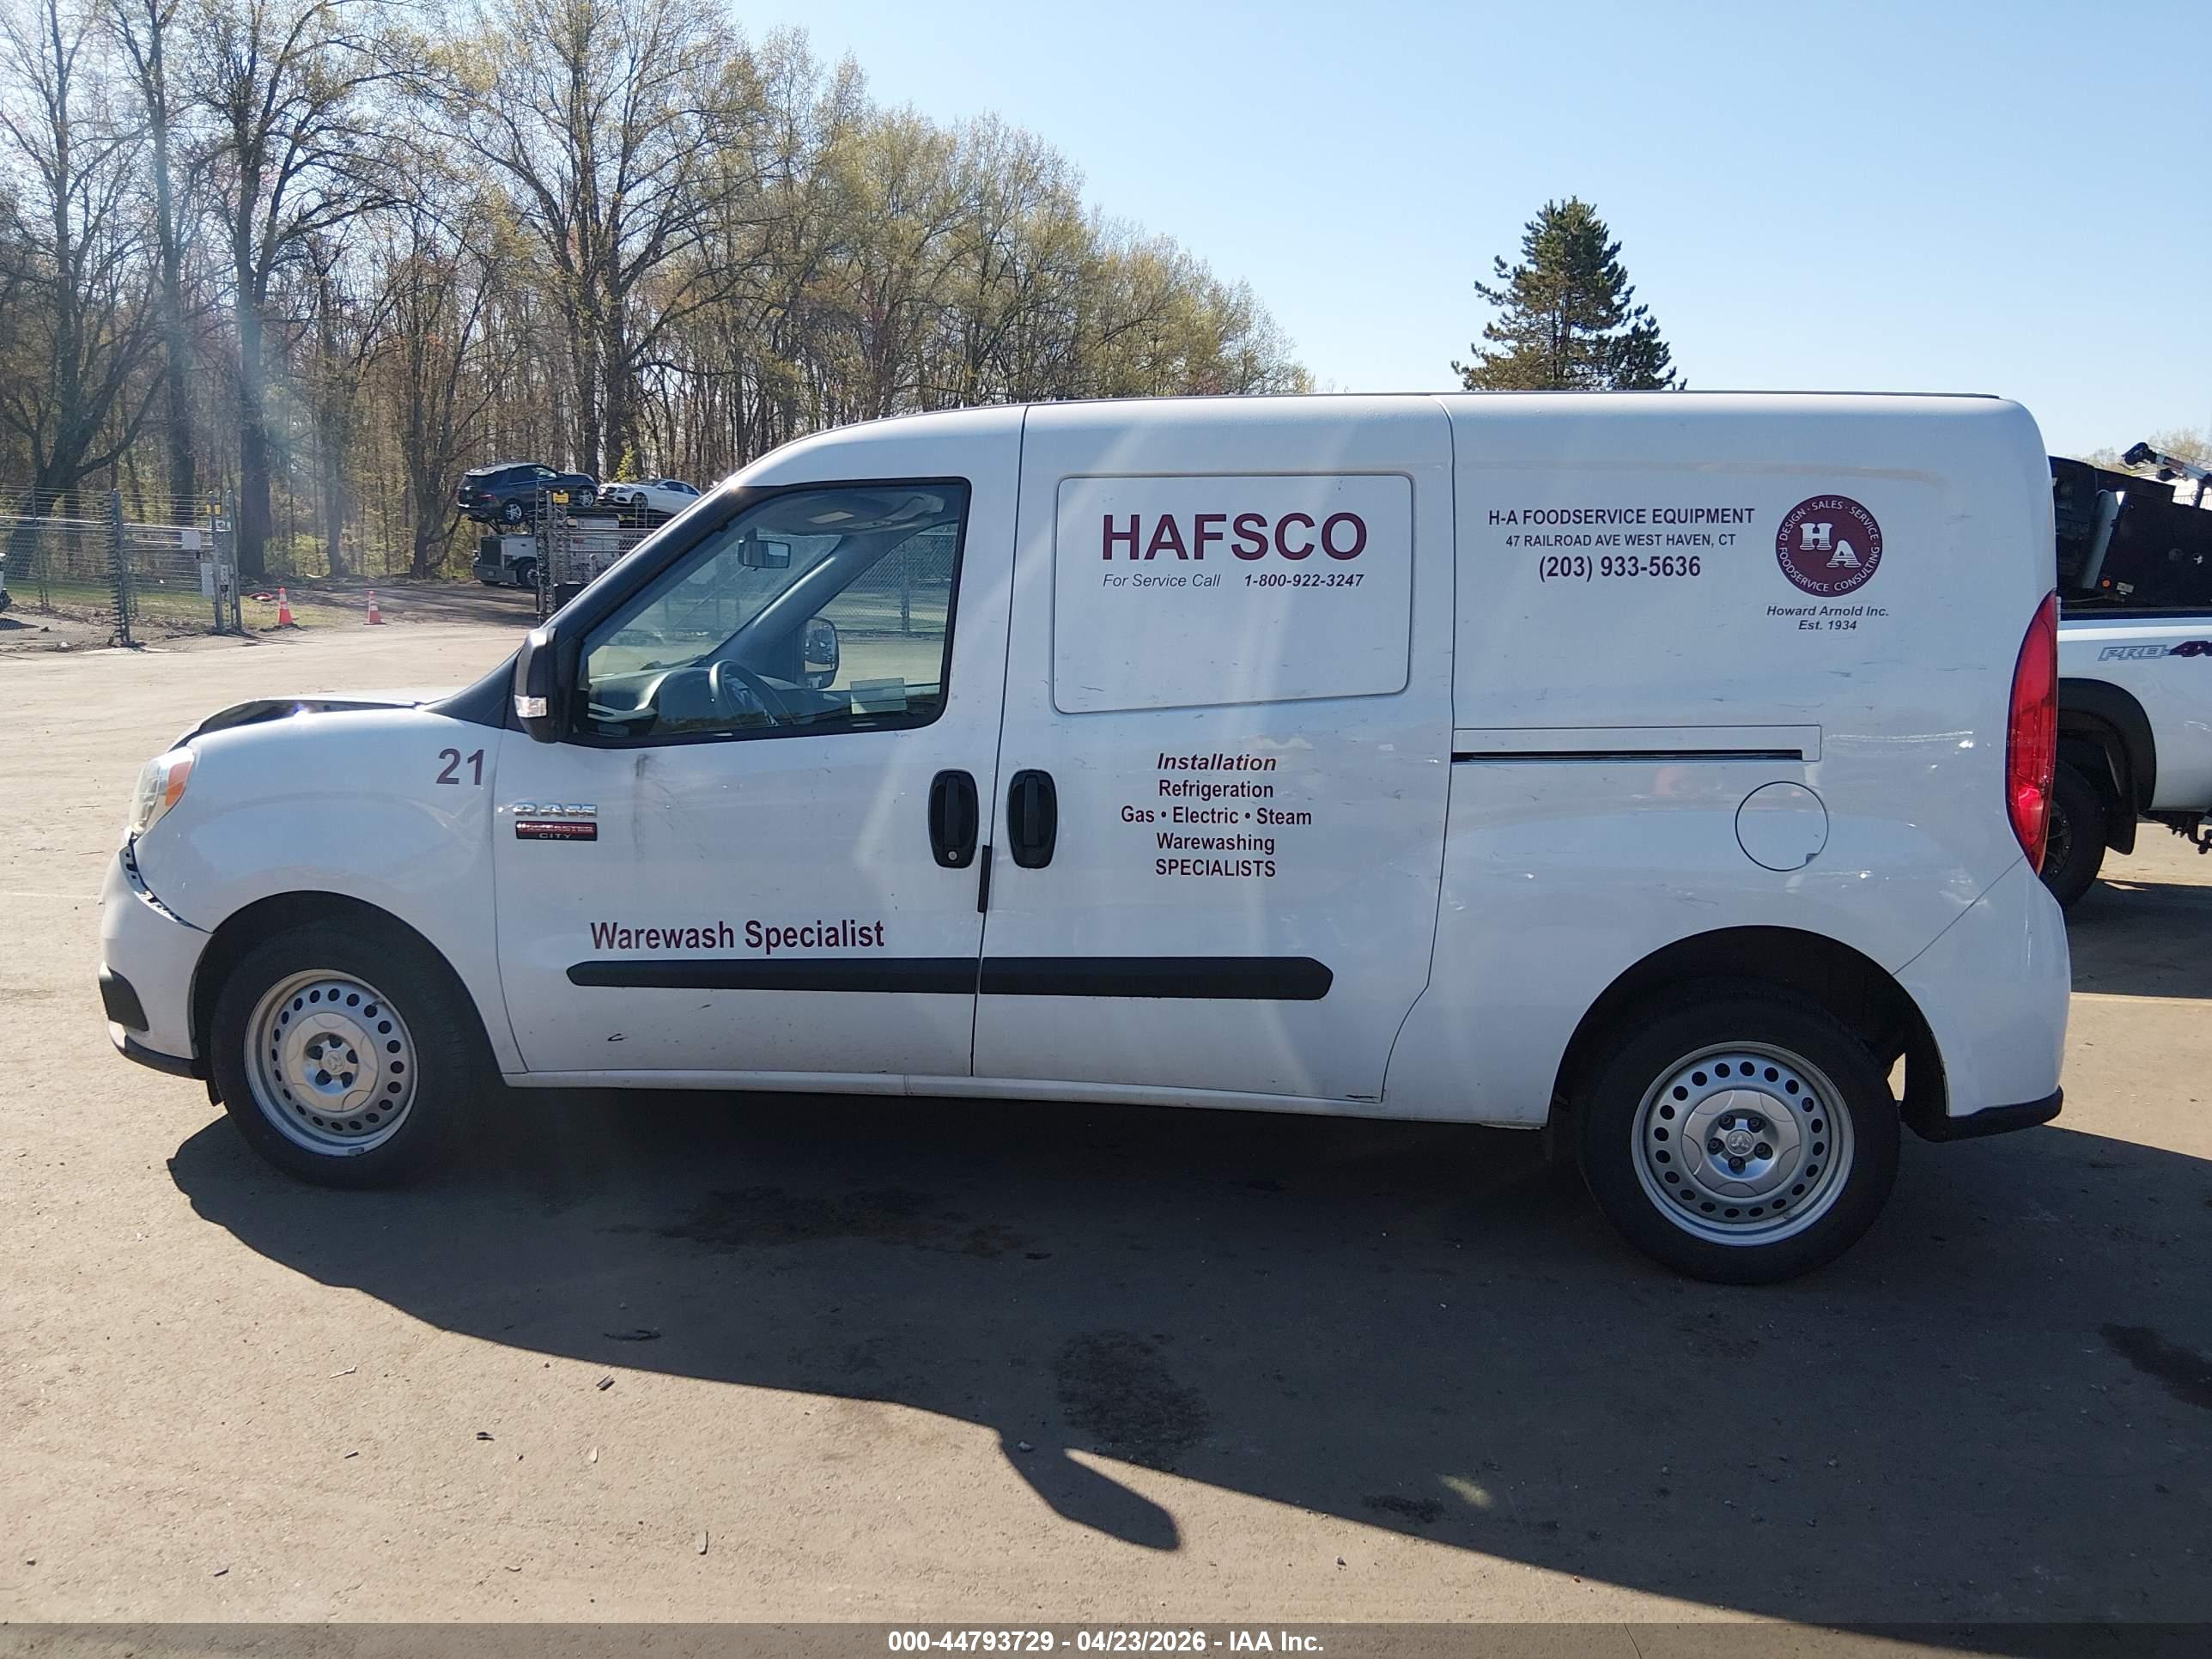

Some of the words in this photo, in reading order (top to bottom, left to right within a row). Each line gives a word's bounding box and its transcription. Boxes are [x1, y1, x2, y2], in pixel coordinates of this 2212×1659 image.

[1490, 510, 1518, 525] H-A
[1523, 509, 1646, 525] FOODSERVICE
[1653, 508, 1754, 524] EQUIPMENT
[1779, 507, 1808, 541] DESIGN
[1811, 500, 1844, 511] SALES
[1849, 506, 1880, 541] SERVICE
[1103, 513, 1367, 560] HAFSCO
[1506, 536, 1520, 546] 47
[1525, 535, 1591, 546] RAILROAD
[1595, 535, 1620, 546] AVE
[1625, 534, 1662, 545] WEST
[1667, 534, 1713, 547] HAVEN,
[1719, 534, 1735, 545] CT
[1540, 556, 1592, 582] (203)
[1601, 556, 1700, 576] 933-5636
[1779, 547, 1830, 592] FOODSERVICE
[1833, 546, 1881, 591] CONSULTING
[1103, 574, 1128, 586] For
[1133, 574, 1186, 586] Service
[1193, 574, 1220, 586] Call
[1245, 574, 1364, 586] 1-800-922-3247
[1767, 606, 1816, 616] Howard
[1819, 606, 1863, 616] Arnold
[1867, 606, 1888, 616] Inc.
[1799, 620, 1822, 629] Est.
[1829, 620, 1856, 629] 1934
[436, 749, 484, 785] 21
[1158, 753, 1276, 770] Installation
[1159, 780, 1273, 801] Refrigeration
[1121, 805, 1154, 823] Gas
[1173, 806, 1238, 823] Electric
[1257, 808, 1311, 824] Steam
[1157, 833, 1274, 855] Warewashing
[1156, 859, 1275, 877] SPECIALISTS
[591, 921, 734, 949] Warewash
[745, 920, 884, 955] Specialist
